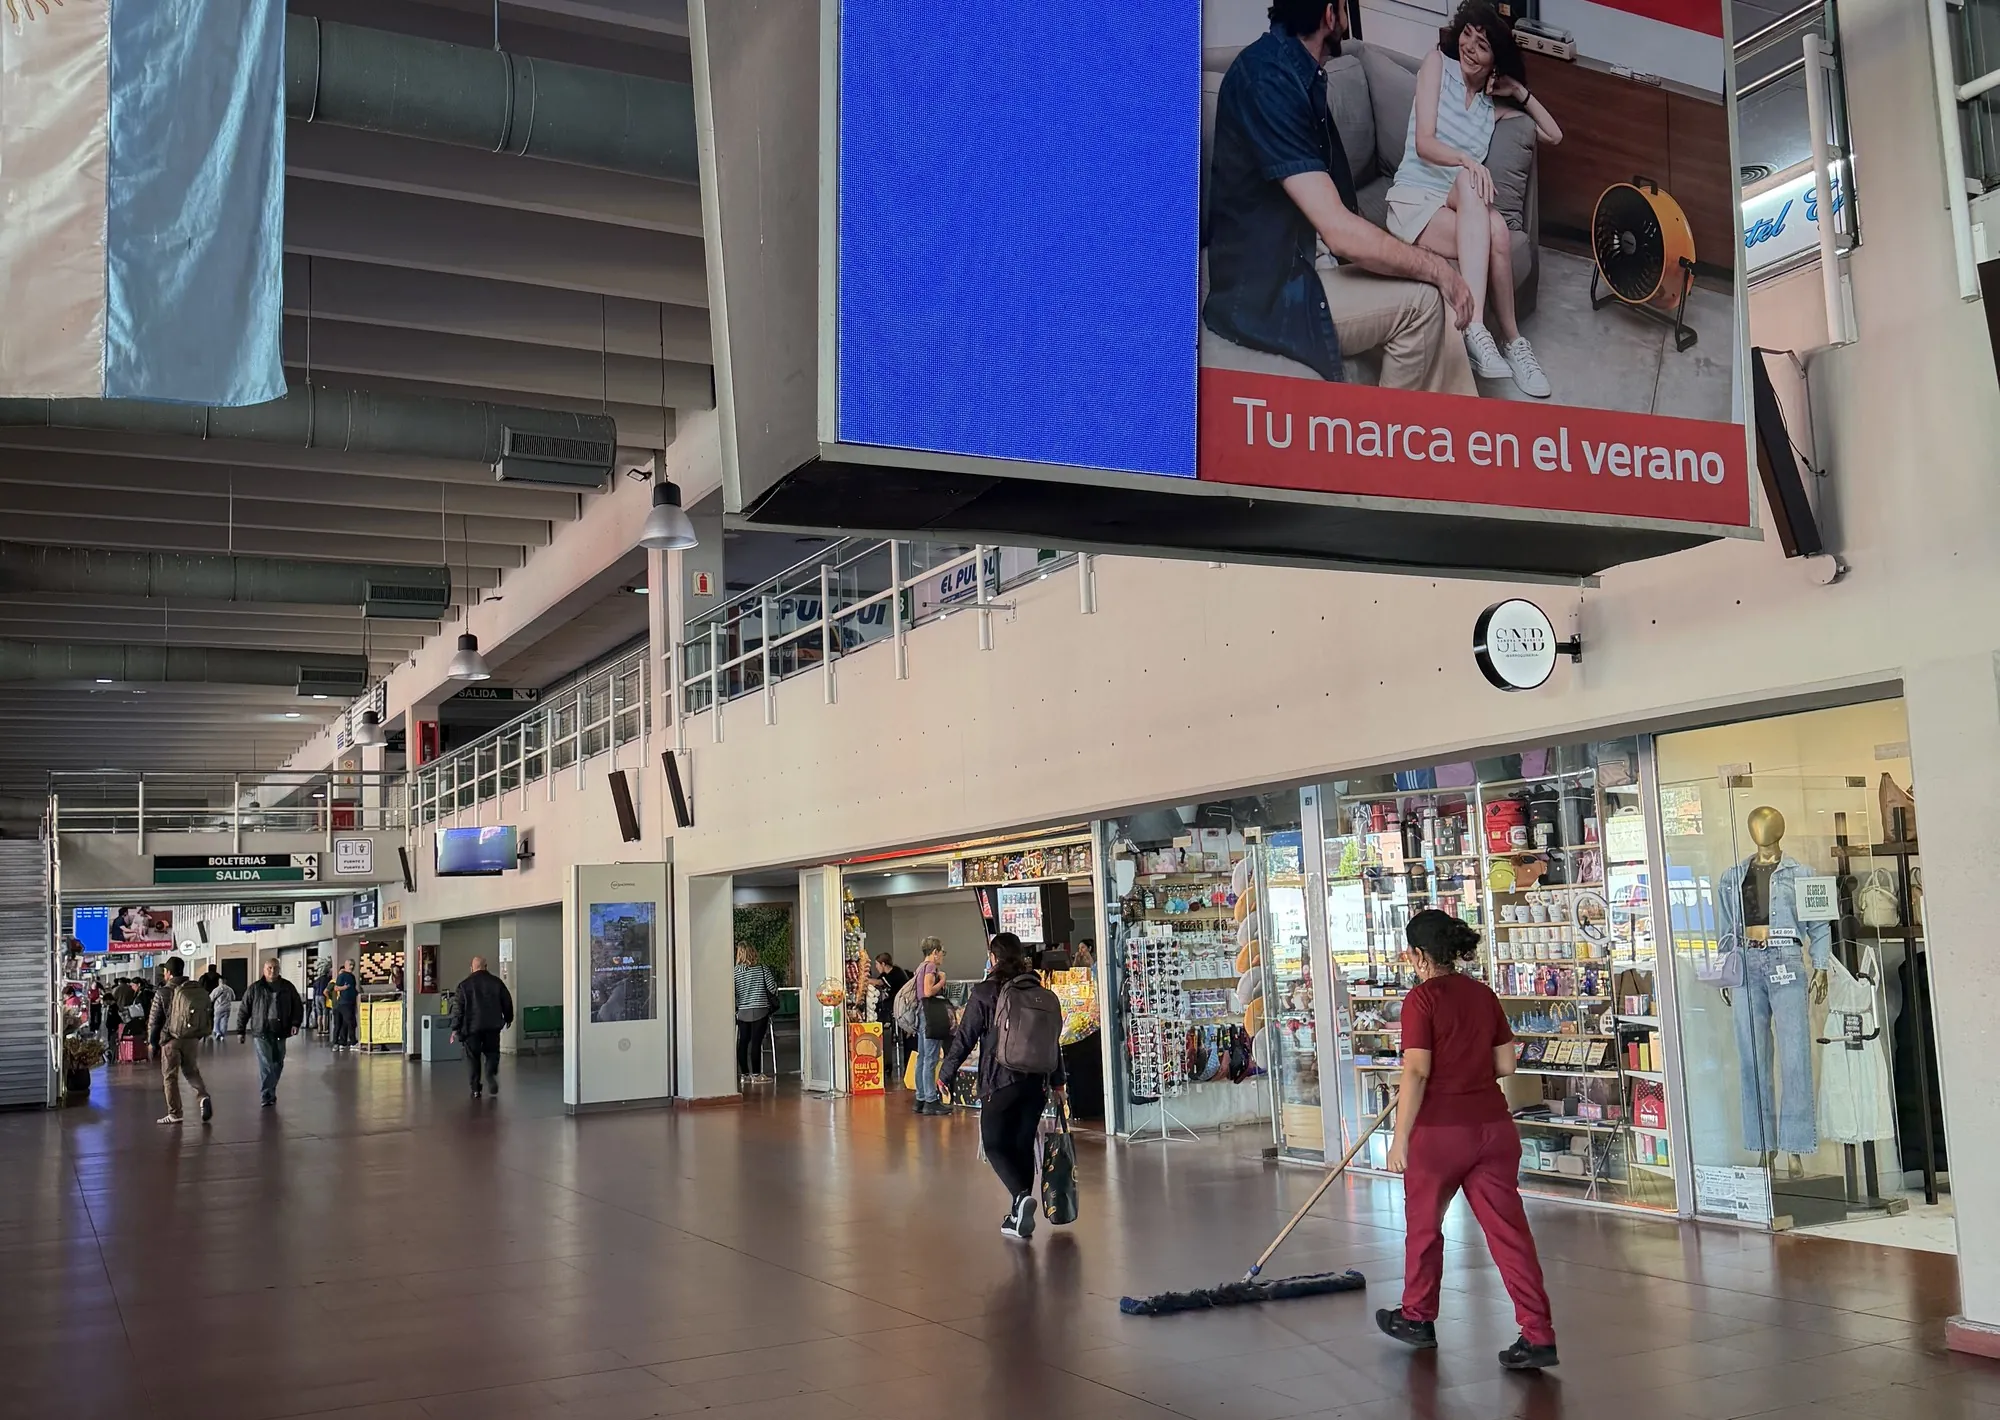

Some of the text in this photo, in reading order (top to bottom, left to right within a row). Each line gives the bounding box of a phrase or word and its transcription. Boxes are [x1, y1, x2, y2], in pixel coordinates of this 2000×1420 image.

[1233, 396, 1726, 485] Tu marca en el verano
[941, 573, 953, 595] EL
[1495, 627, 1545, 653] SND
[458, 688, 498, 698] SALIDA
[208, 856, 267, 866] BOLETERIAS
[215, 870, 261, 881] SALIDA
[283, 906, 291, 915] 3
